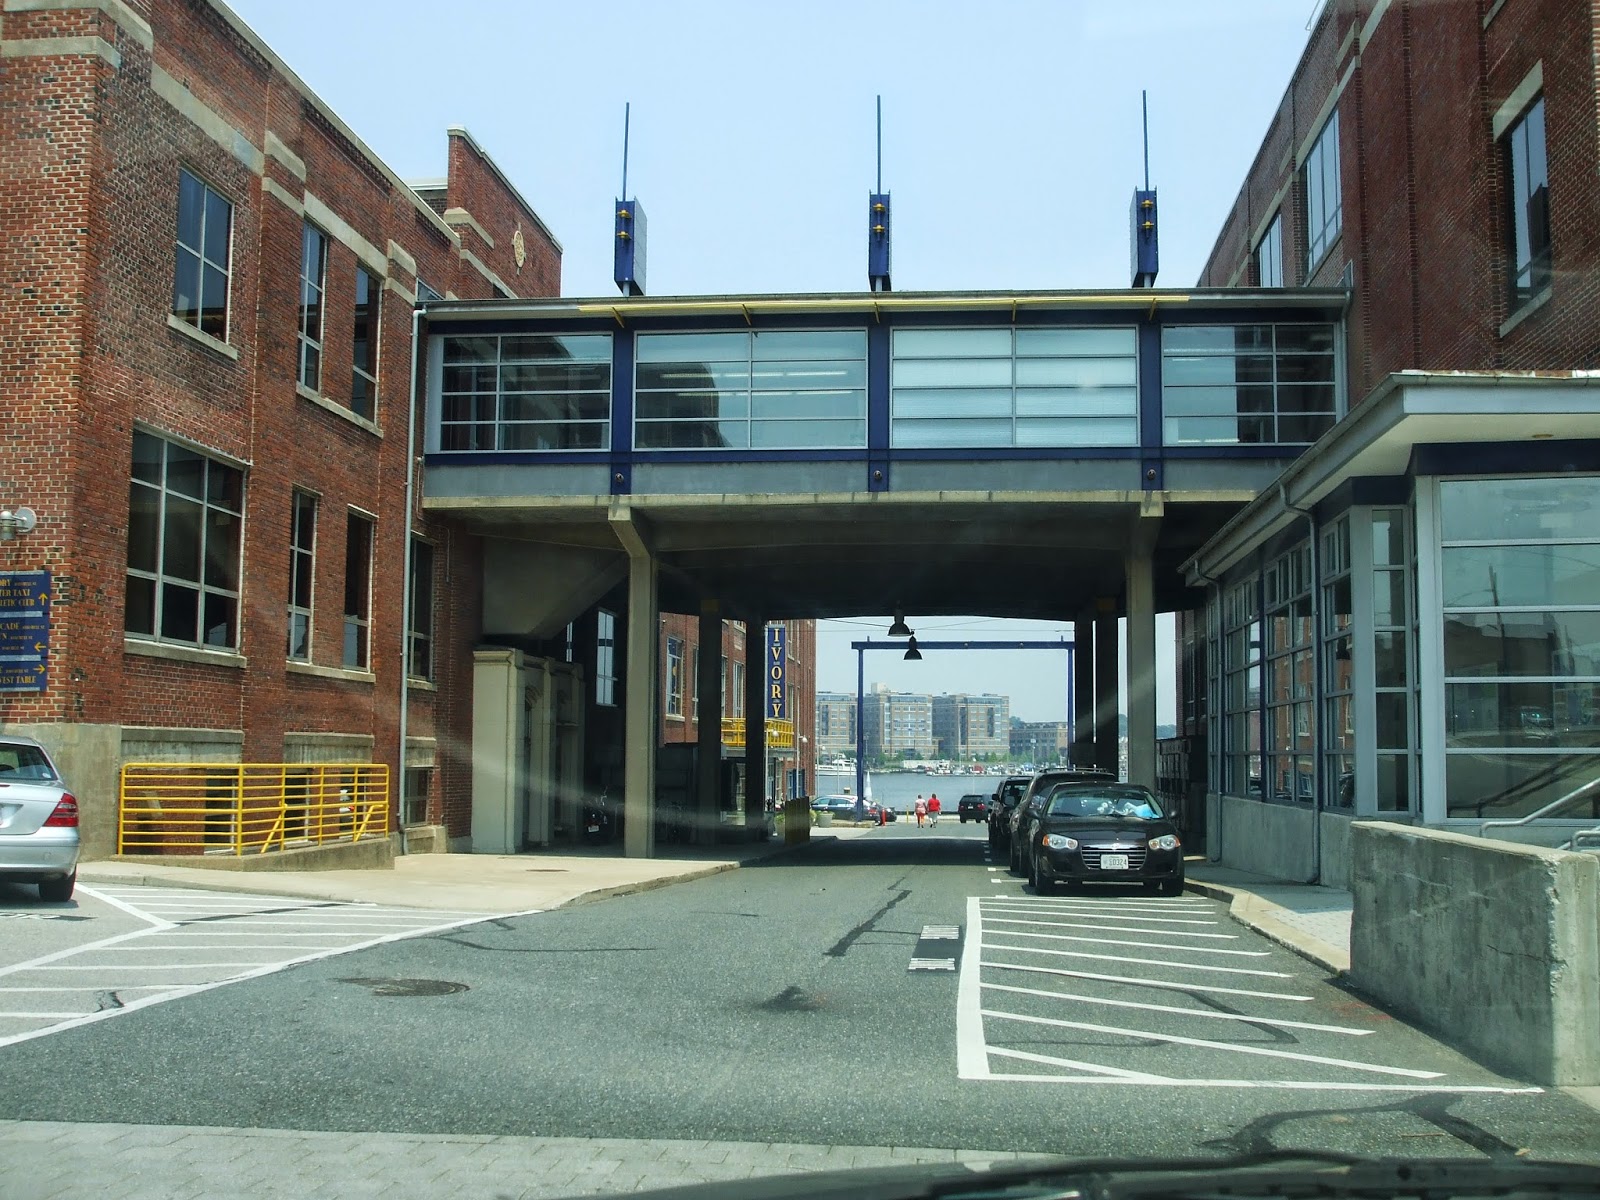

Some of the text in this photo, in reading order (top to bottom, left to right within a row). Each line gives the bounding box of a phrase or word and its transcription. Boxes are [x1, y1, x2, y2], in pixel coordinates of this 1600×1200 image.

[14, 588, 31, 597] TAXI
[771, 628, 782, 717] IVORY
[16, 676, 37, 684] TABLE
